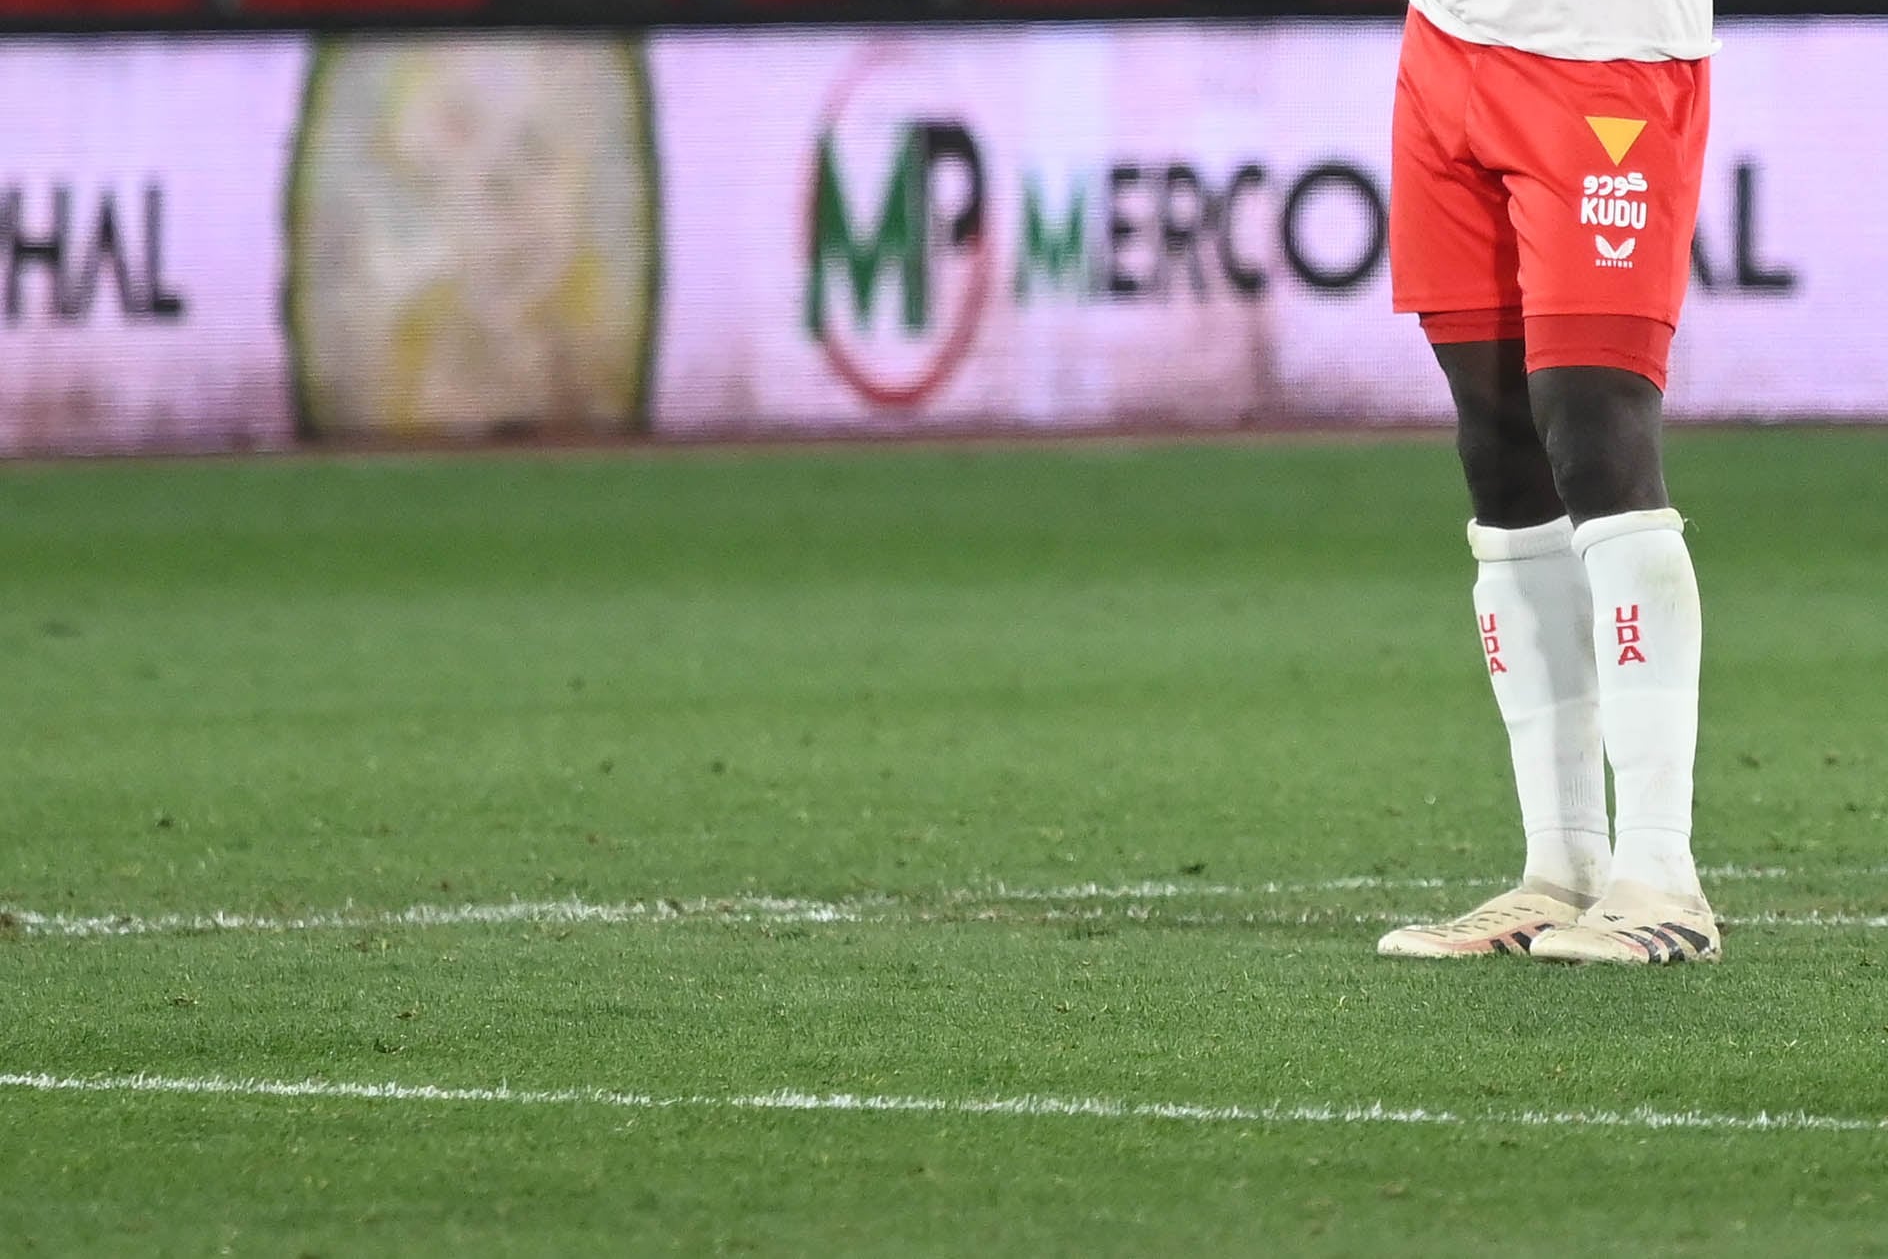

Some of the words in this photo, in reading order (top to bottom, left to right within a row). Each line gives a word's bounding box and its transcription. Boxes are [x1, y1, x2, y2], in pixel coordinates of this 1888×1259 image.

[1014, 156, 1798, 296] MERCOL
[1580, 197, 1647, 229] KUDU
[0, 181, 185, 323] HAL
[1479, 613, 1507, 675] UDA
[1615, 604, 1647, 666] UDA
